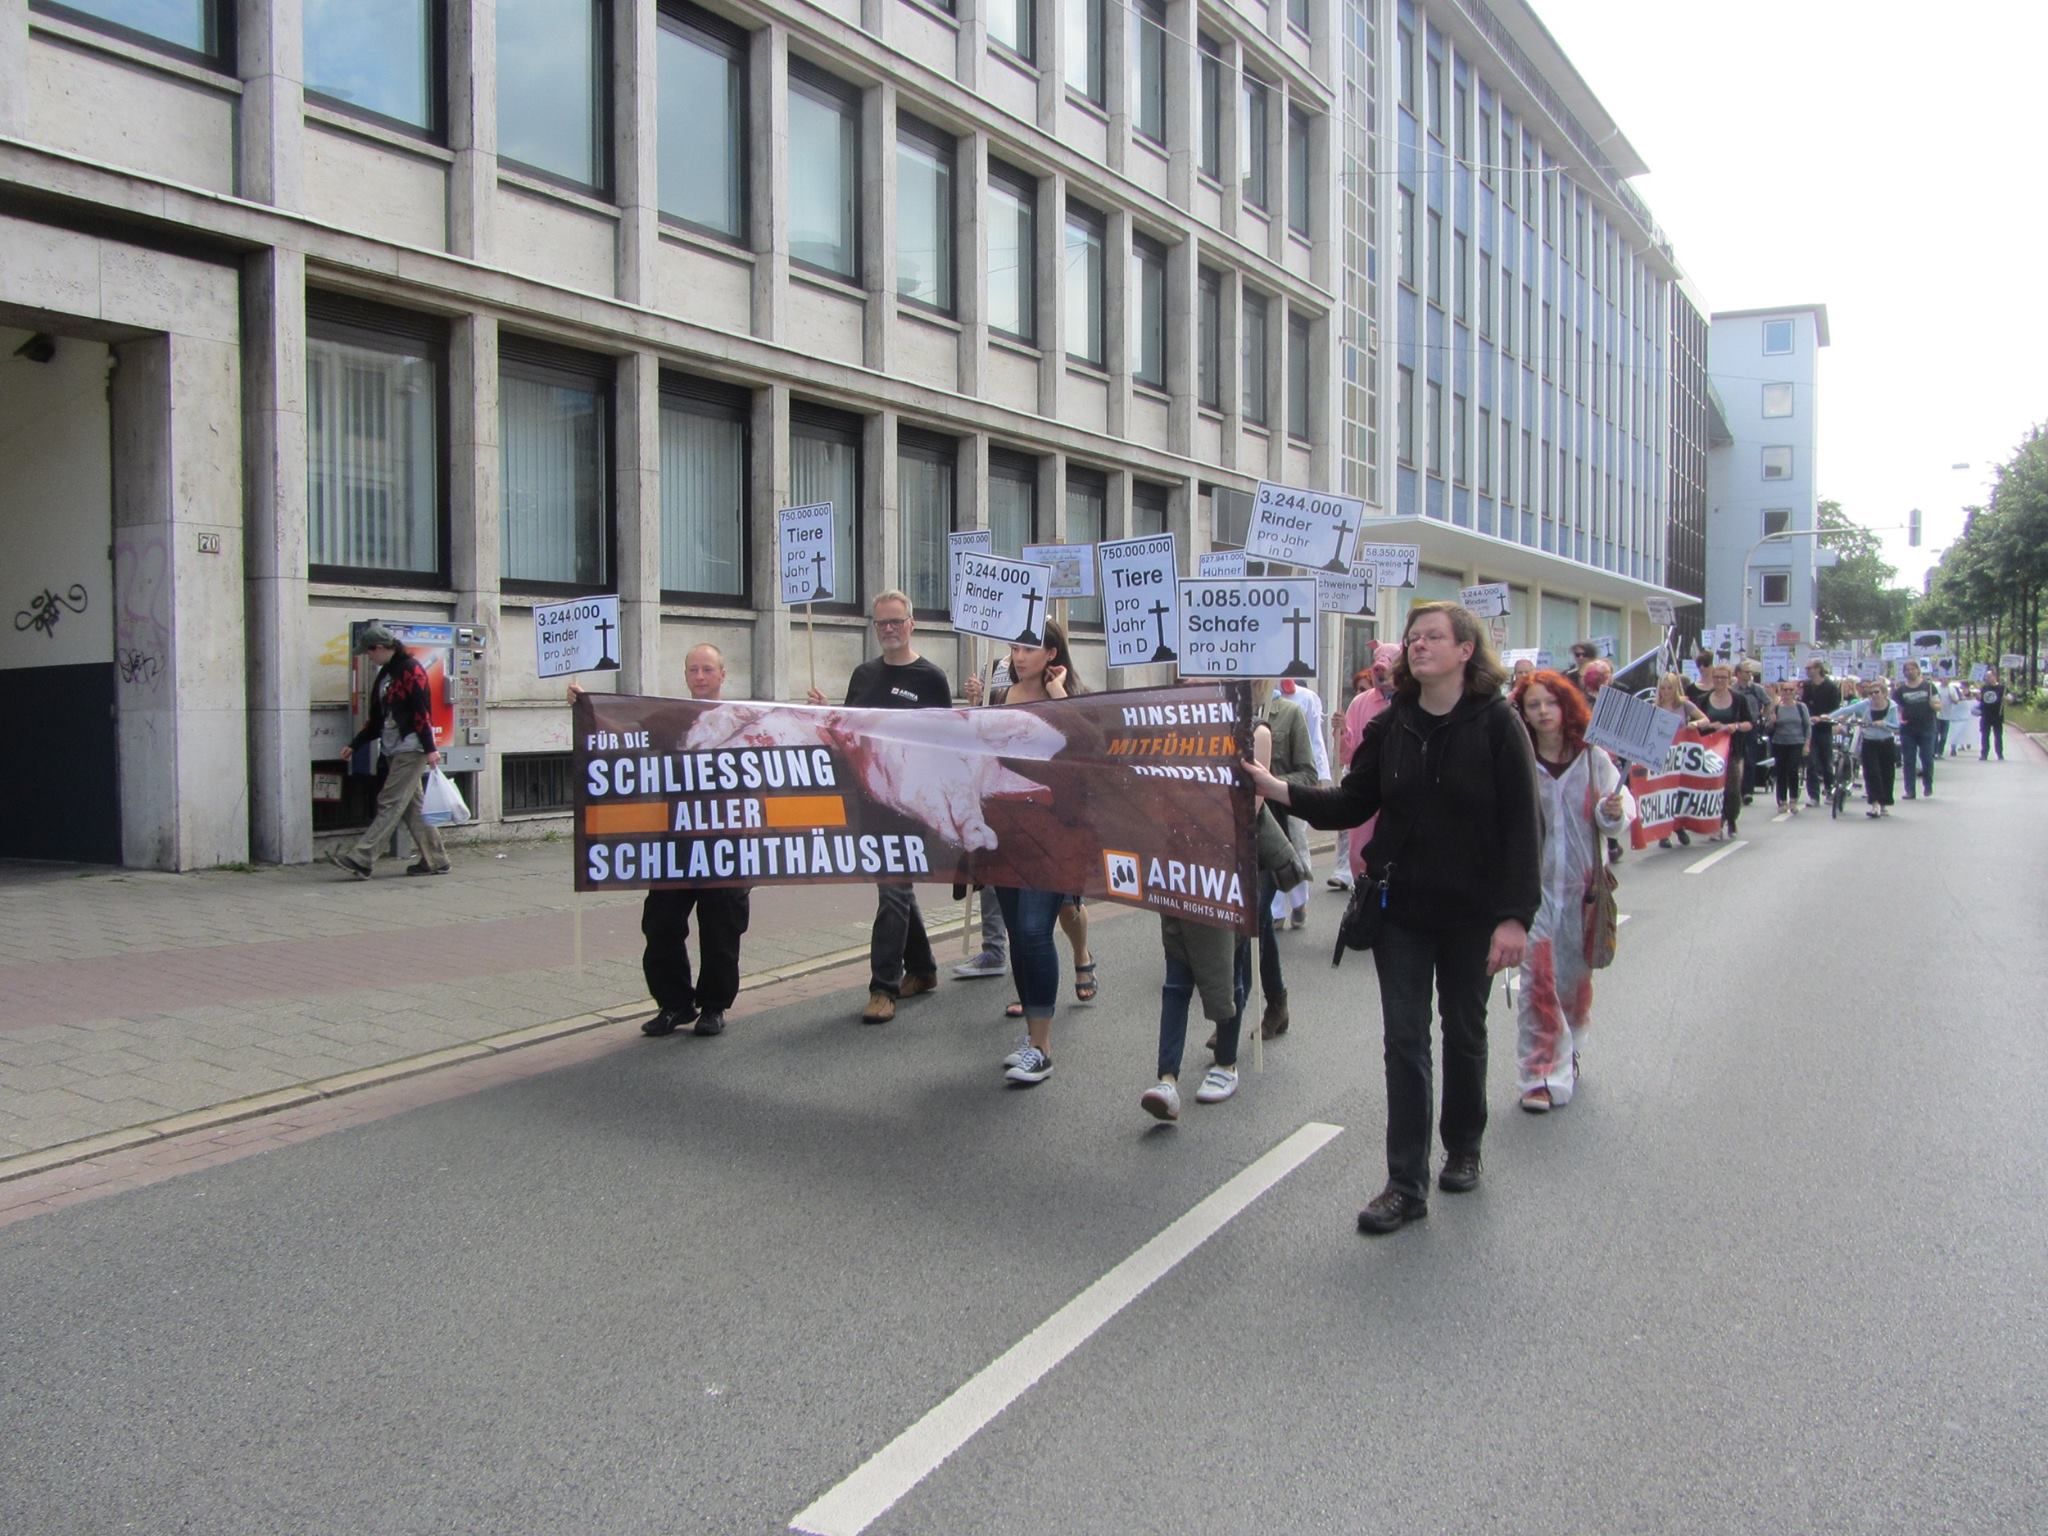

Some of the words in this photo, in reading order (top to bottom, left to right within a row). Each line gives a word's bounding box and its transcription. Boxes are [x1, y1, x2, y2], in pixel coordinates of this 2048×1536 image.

[1260, 490, 1342, 518] 3.244.000
[781, 506, 829, 521] 750.000.000
[1261, 510, 1312, 531] Rinder
[201, 535, 218, 551] 70
[787, 528, 823, 543] Tiere
[1257, 530, 1278, 541] pro
[1281, 534, 1310, 548] Jahr
[788, 550, 805, 564] pro
[1102, 541, 1170, 560] 750.000.000
[1268, 545, 1279, 556] in
[1283, 547, 1293, 558] D
[784, 566, 809, 578] Jahr
[965, 560, 1030, 585] 3.244.000
[1111, 568, 1163, 588] Tiere
[788, 583, 798, 594] in
[801, 581, 810, 593] D
[965, 582, 1003, 602] Rinder
[1115, 598, 1140, 614] pro
[1184, 588, 1289, 607] 1.085.000
[538, 605, 600, 626] 3.244.000
[963, 603, 977, 615] pro
[980, 604, 1002, 619] Jahr
[971, 619, 978, 629] in
[981, 620, 989, 631] D
[1112, 617, 1146, 633] Jahr
[1188, 615, 1260, 632] Schafe
[543, 629, 578, 644] Rinder
[544, 650, 559, 661] pro
[562, 646, 580, 657] Jahr
[1118, 640, 1131, 655] in
[1137, 638, 1147, 653] D
[1189, 641, 1215, 655] pro
[1220, 640, 1256, 653] Jahr
[555, 662, 563, 672] in
[565, 660, 571, 670] D
[1207, 658, 1220, 671] in
[1226, 658, 1238, 671] D
[1122, 702, 1241, 726] HINSEHEN.
[587, 729, 619, 751] FÜR
[625, 731, 650, 749] DIE
[1106, 732, 1243, 756] MITFÜHLEN.
[587, 749, 836, 796] SCHLIESSUNG
[674, 798, 761, 832] ALLER
[588, 828, 930, 882] SCHLACHTHÄUSER
[1147, 857, 1244, 908] ARIWA
[1148, 894, 1180, 910] ANIMAL
[1183, 901, 1214, 917] RIGHTS
[1216, 908, 1246, 925] WATCH
